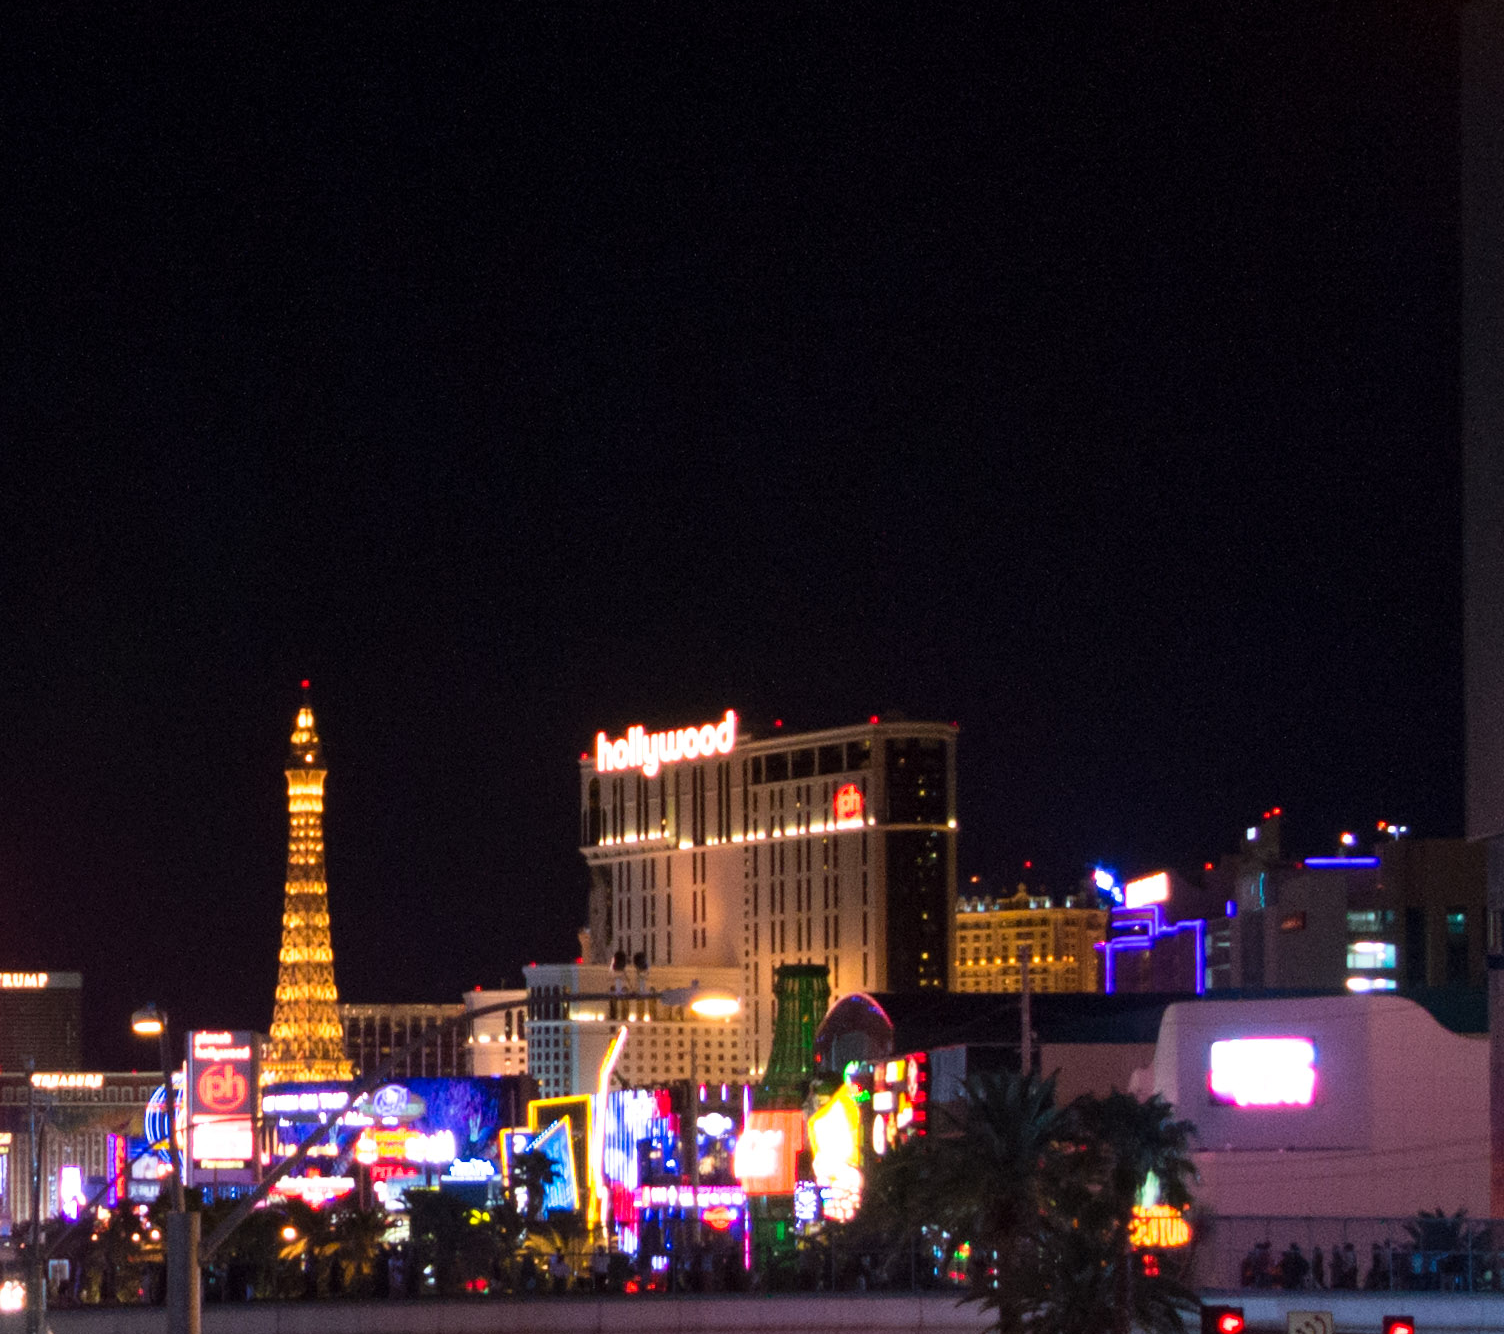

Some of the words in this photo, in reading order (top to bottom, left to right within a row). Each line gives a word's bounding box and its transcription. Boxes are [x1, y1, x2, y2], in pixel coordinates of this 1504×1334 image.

[596, 709, 735, 776] hollywood
[31, 1073, 104, 1088] TREASURE
[205, 1064, 245, 1104] ph
